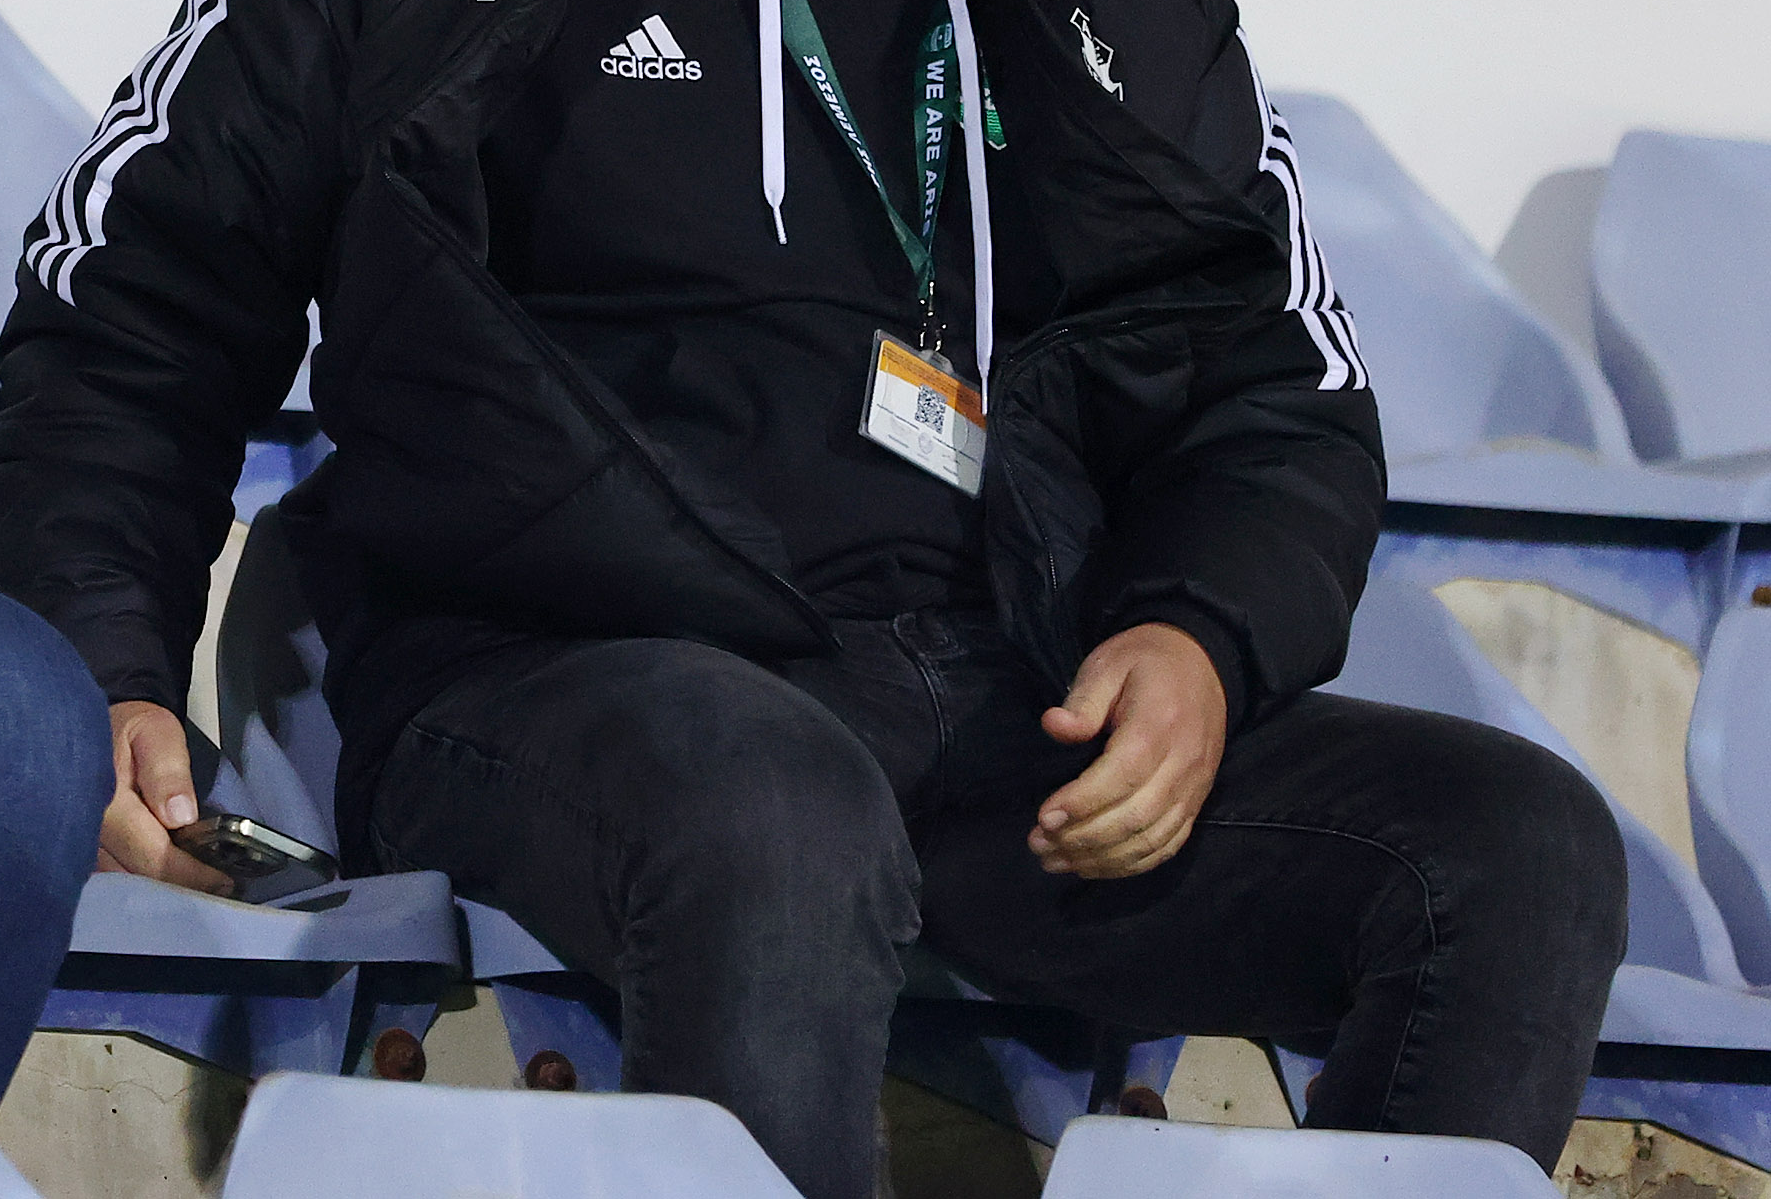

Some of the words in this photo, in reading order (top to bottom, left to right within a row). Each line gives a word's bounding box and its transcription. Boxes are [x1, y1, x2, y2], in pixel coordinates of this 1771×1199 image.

[600, 55, 703, 81] adidas
[925, 58, 946, 100] WE
[925, 107, 944, 162] ARE
